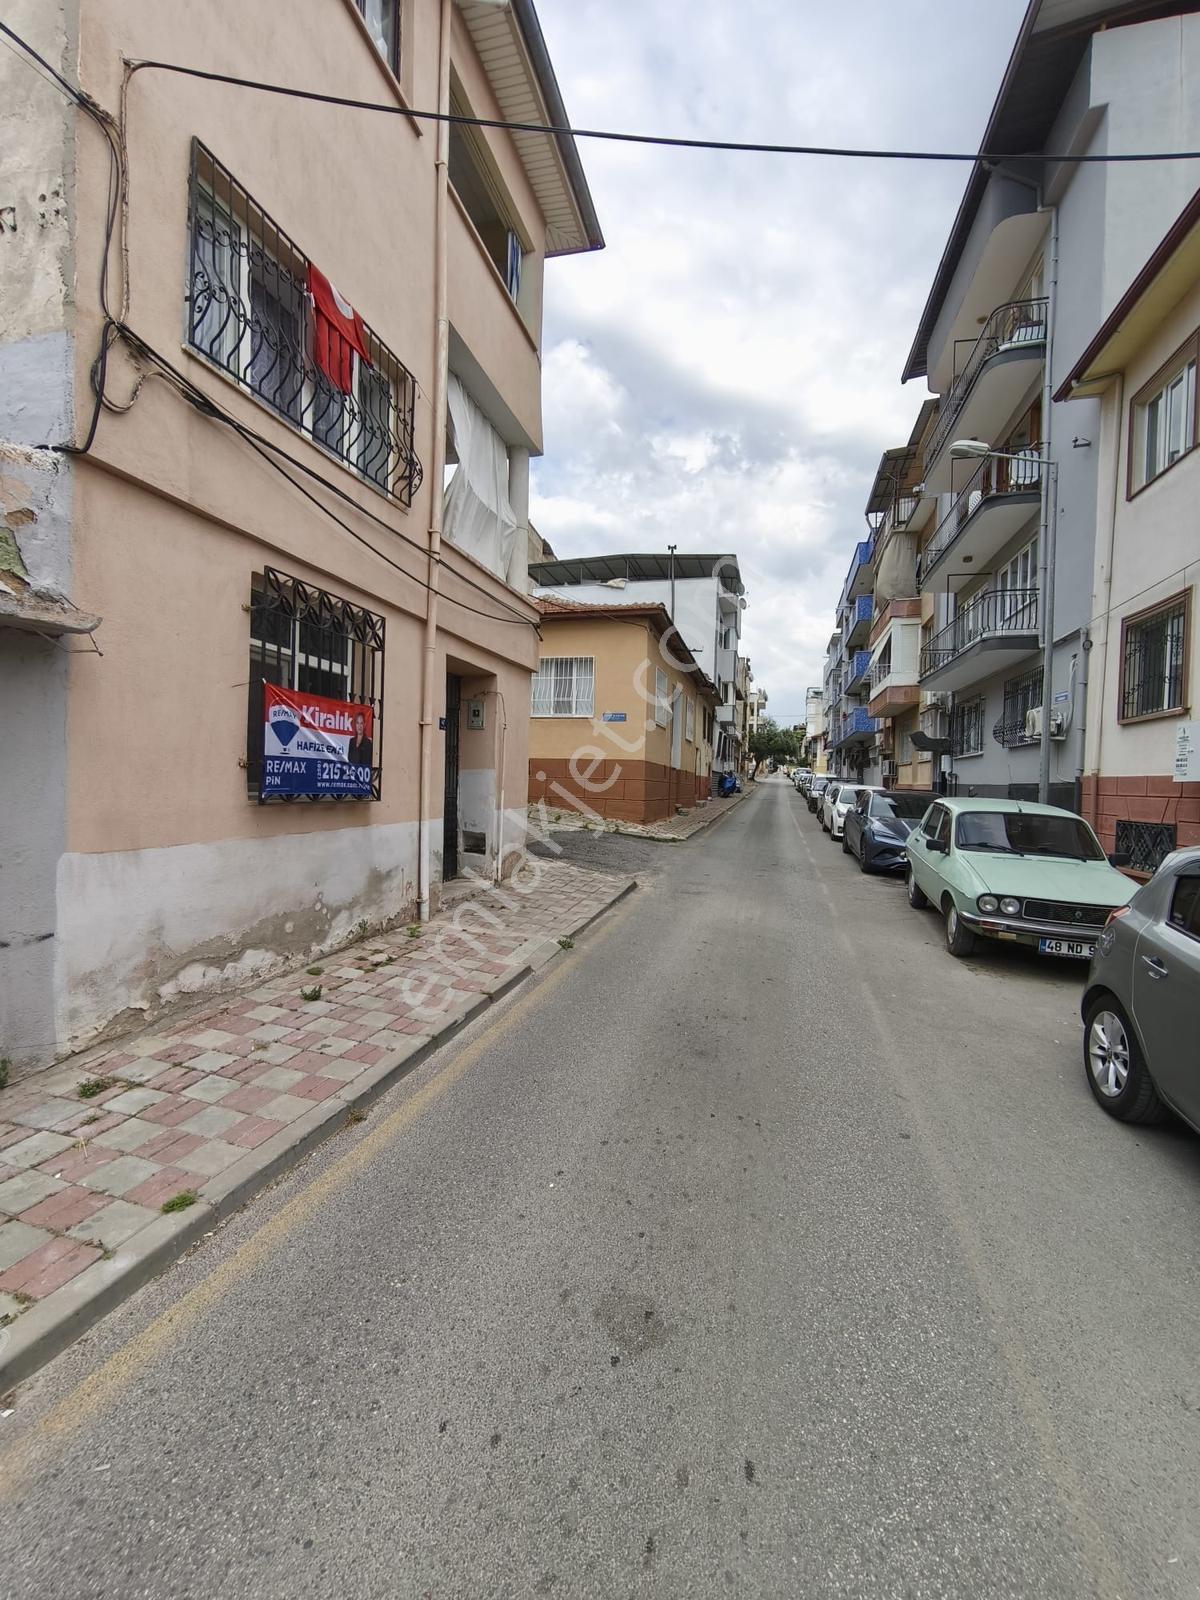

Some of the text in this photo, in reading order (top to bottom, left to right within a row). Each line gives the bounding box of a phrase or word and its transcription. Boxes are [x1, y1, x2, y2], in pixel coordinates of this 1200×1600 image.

[302, 705, 353, 732] Kiralık
[266, 760, 306, 774] RE/MAX
[322, 762, 341, 780] 215
[357, 767, 371, 783] 00
[1047, 941, 1062, 952] 48
[1067, 943, 1083, 954] ND
